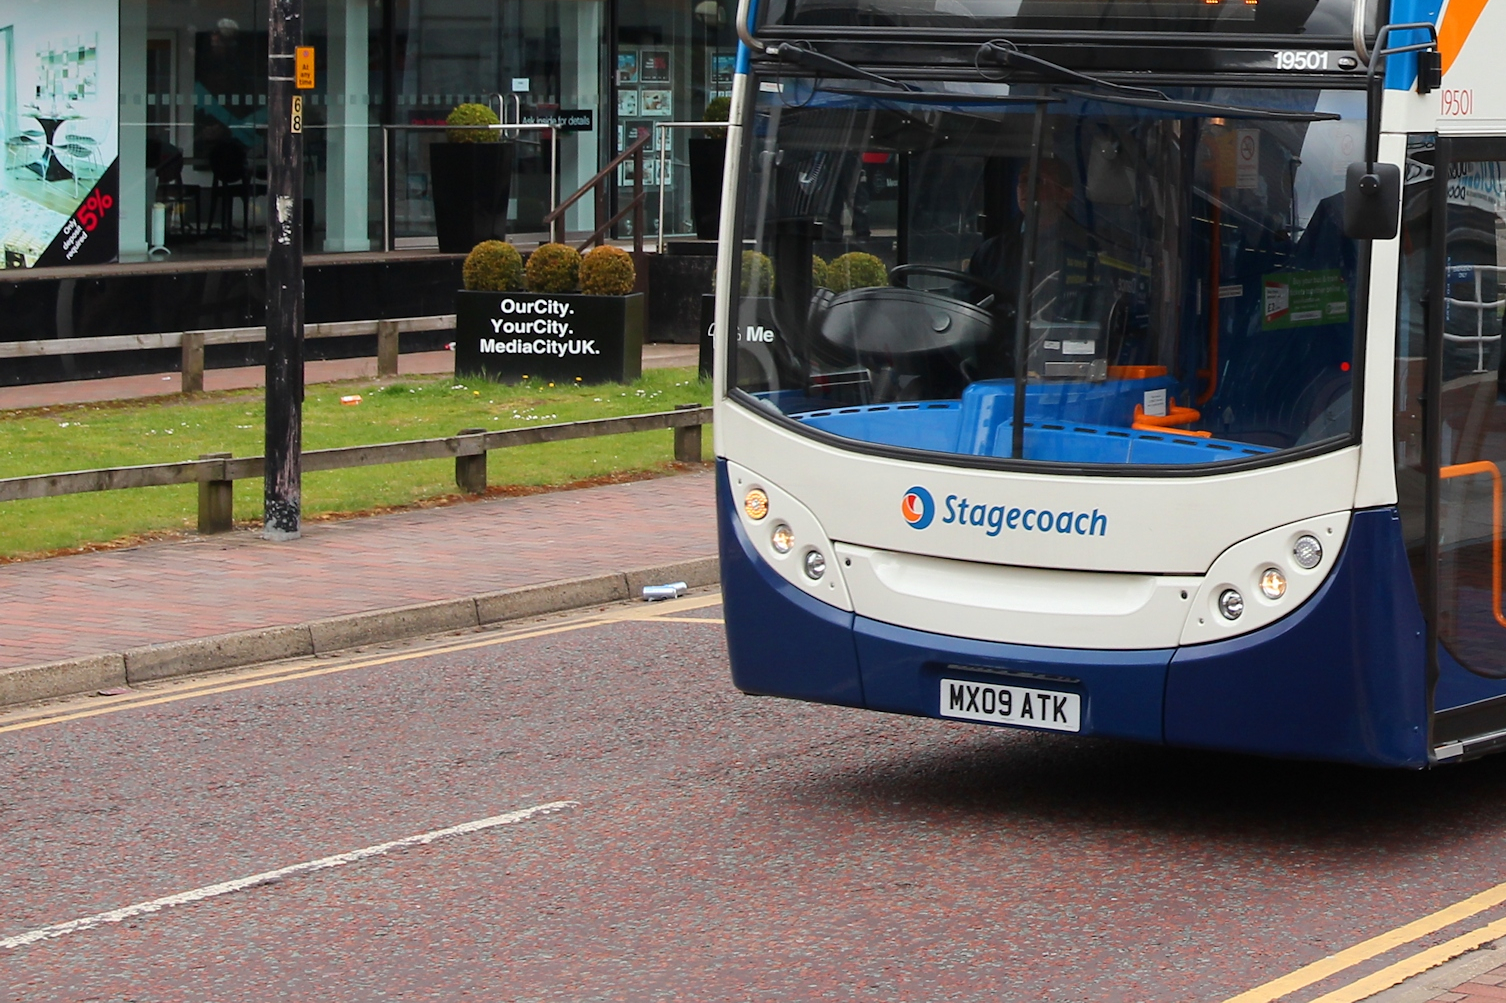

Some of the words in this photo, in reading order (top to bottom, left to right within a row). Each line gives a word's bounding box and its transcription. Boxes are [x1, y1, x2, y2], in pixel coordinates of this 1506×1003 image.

[1273, 51, 1329, 70] 19501
[1441, 89, 1473, 116] 19501
[558, 116, 568, 125] for
[568, 115, 591, 126] details
[76, 188, 113, 232] 5%
[501, 298, 575, 318] OurCity.
[490, 318, 574, 337] YourCity.
[480, 338, 600, 357] MediaCityUK.
[942, 494, 1109, 537] Stagecoach
[950, 683, 1012, 716] MX09
[1020, 692, 1068, 723] ATK
